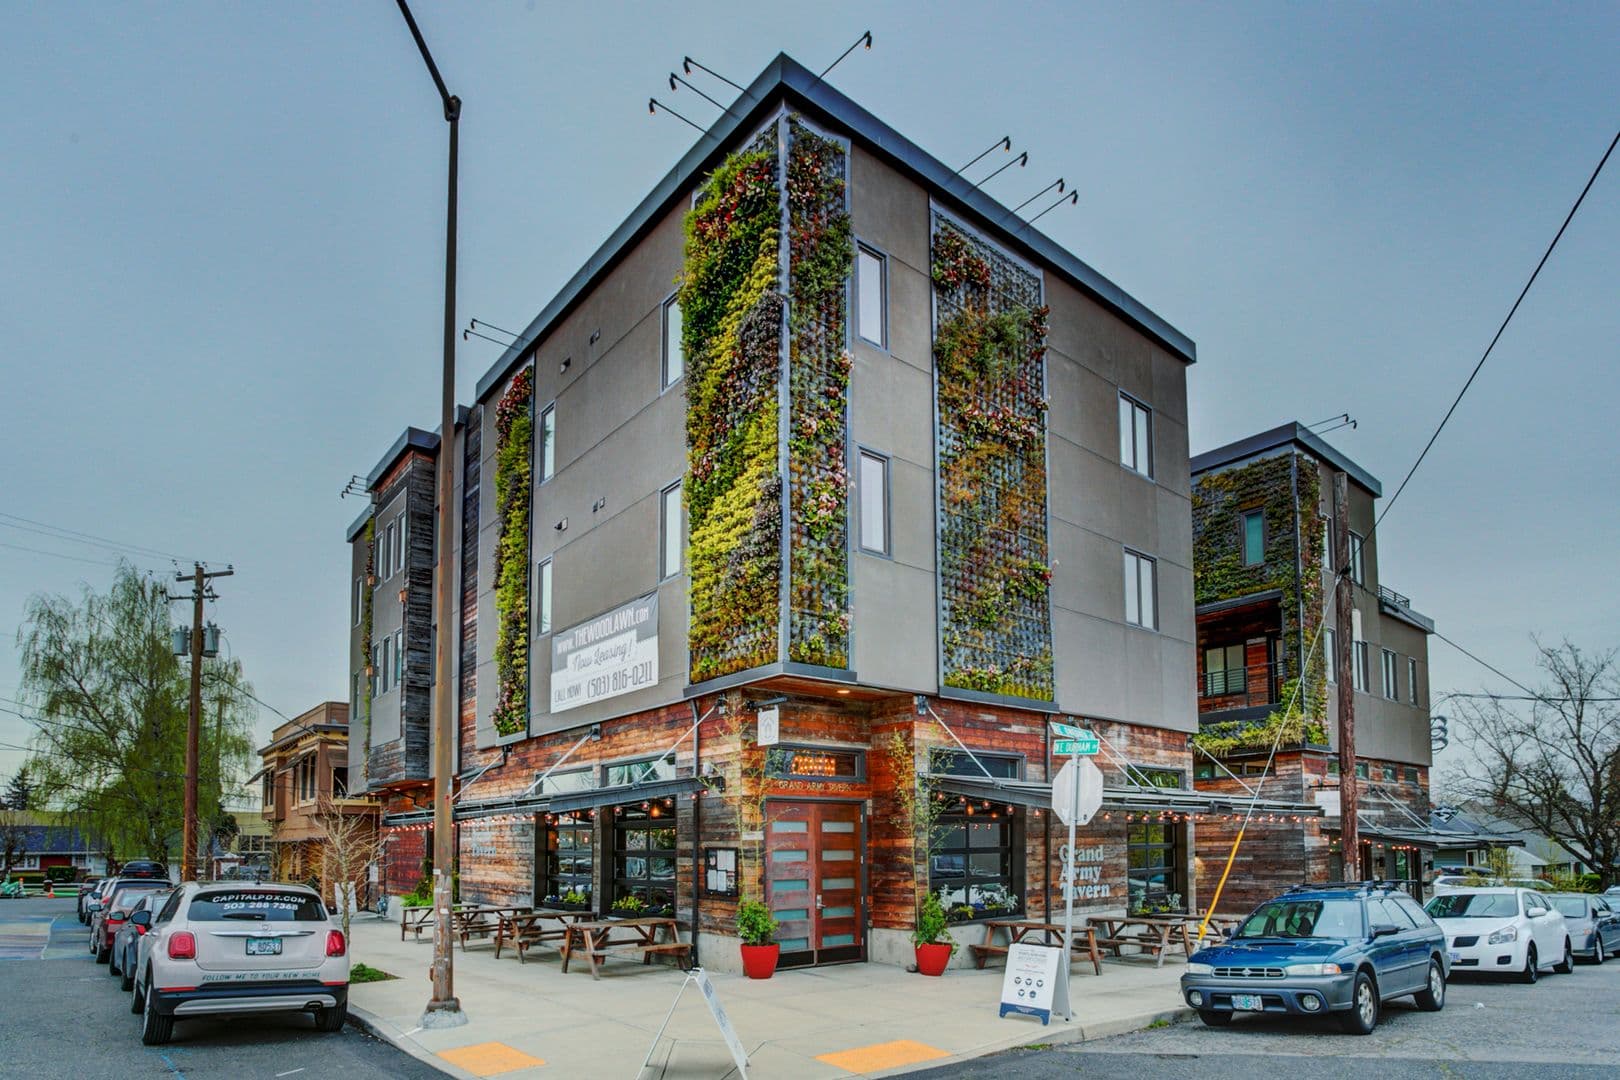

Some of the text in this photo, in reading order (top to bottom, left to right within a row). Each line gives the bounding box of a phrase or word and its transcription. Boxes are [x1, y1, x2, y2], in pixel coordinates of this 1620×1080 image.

[573, 652, 592, 671] Now
[554, 687, 566, 702] CALL
[587, 675, 610, 698] (503)
[612, 661, 653, 692] 816-0211
[1058, 844, 1104, 863] Grand
[1059, 863, 1102, 883] Army
[212, 893, 306, 905] CAPITALPDX.COM
[1060, 882, 1110, 900] Tavern
[223, 902, 245, 910] 503
